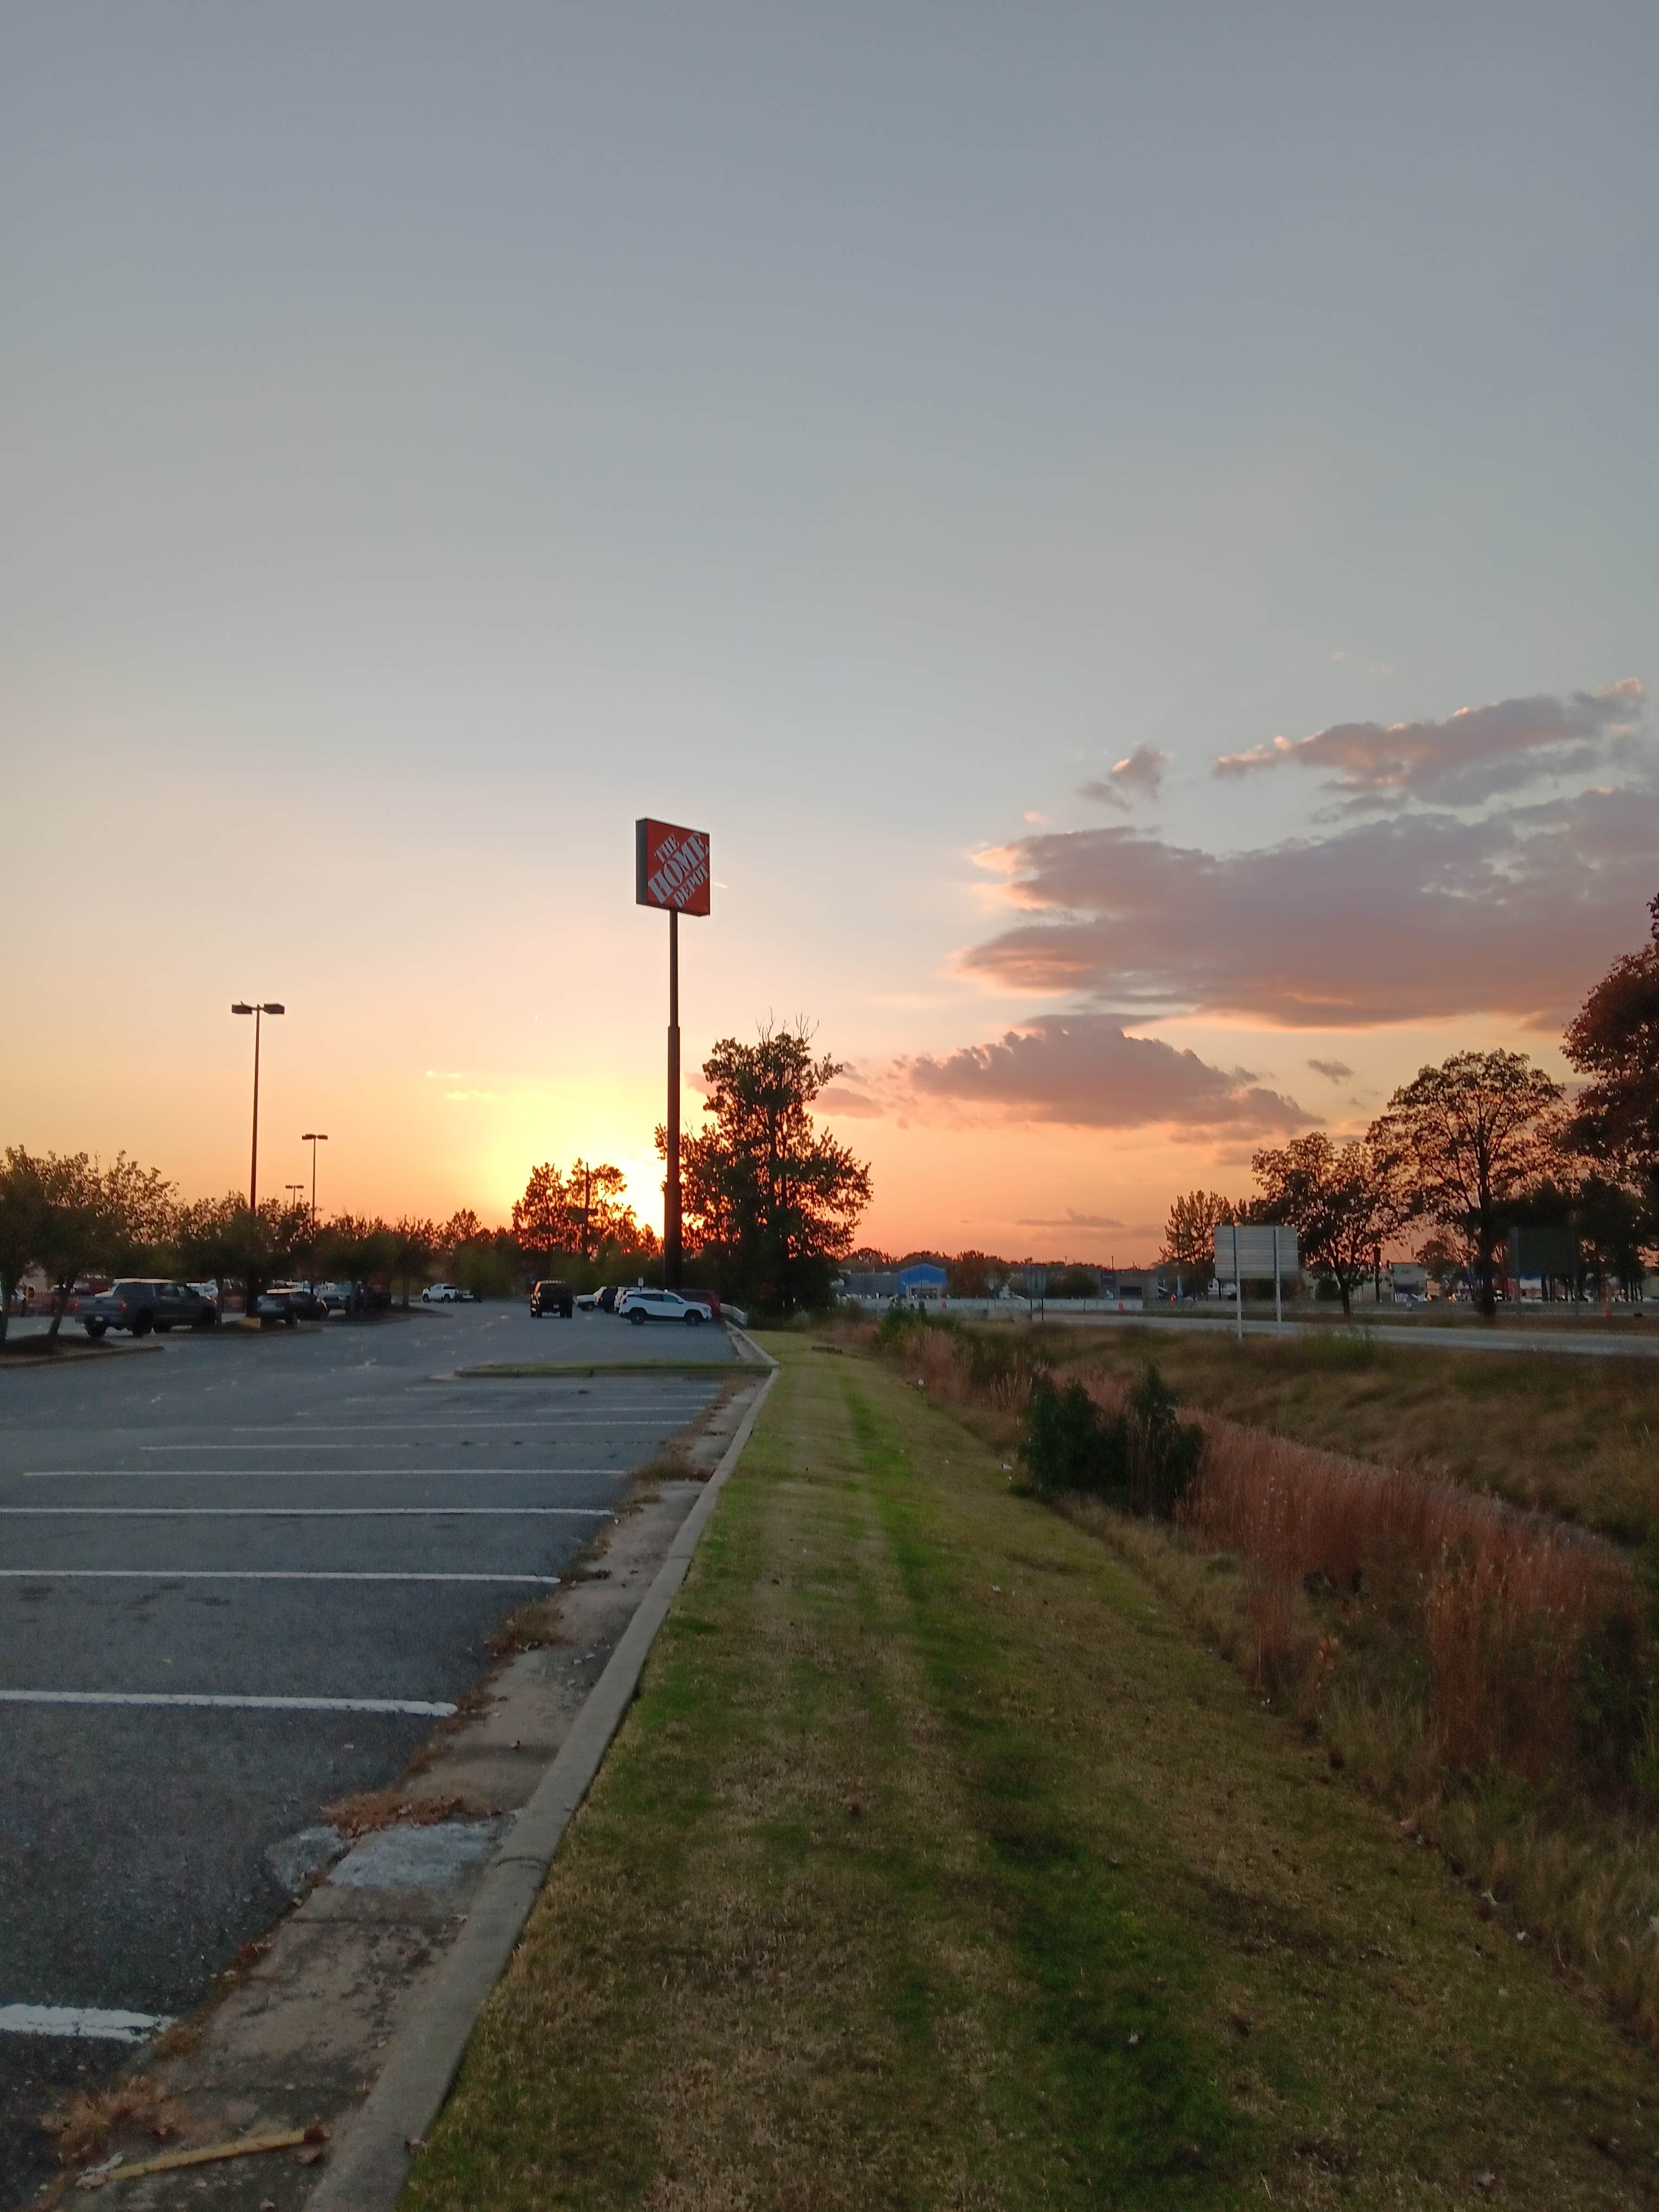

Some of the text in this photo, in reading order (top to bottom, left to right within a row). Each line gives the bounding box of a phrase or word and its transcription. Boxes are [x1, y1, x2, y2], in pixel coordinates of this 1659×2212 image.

[648, 832, 709, 904] HOME
[654, 834, 679, 863] THE
[673, 863, 709, 908] DEPOT
